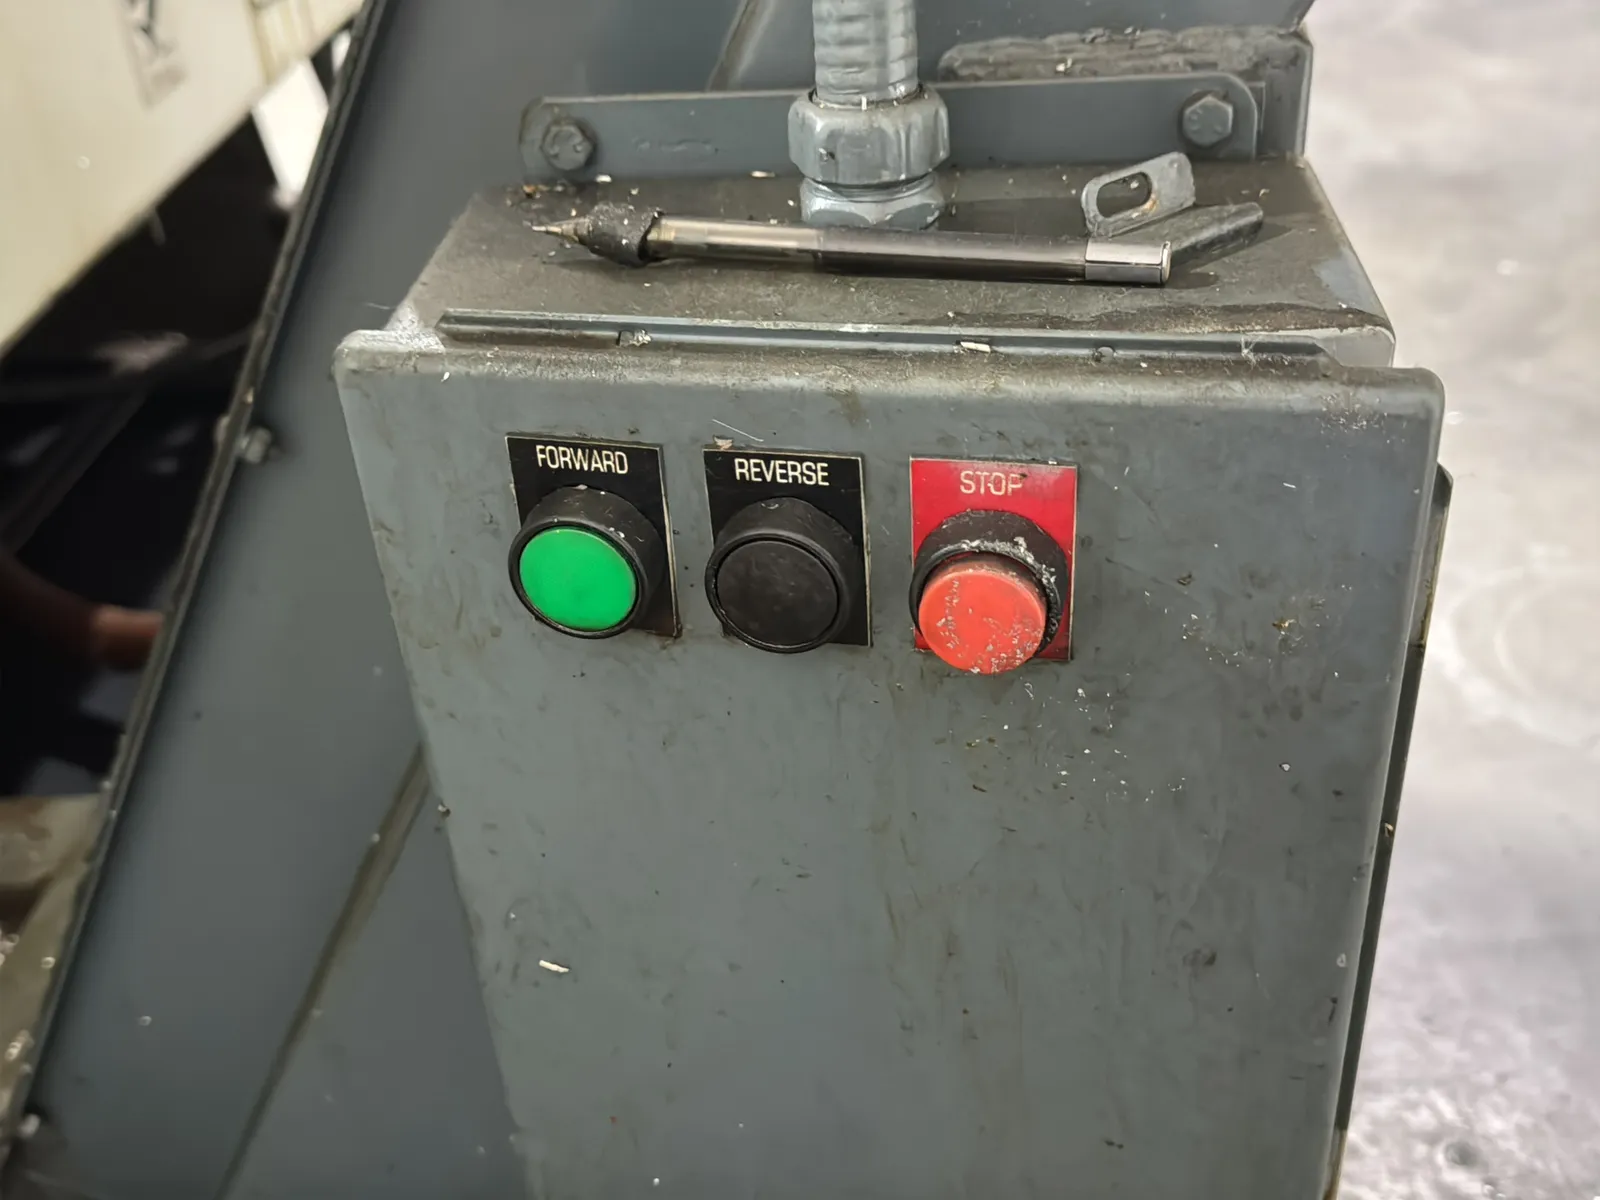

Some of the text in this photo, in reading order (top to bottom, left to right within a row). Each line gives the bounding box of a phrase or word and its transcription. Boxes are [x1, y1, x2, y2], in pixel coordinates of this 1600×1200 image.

[535, 444, 629, 475] FORWARD
[733, 457, 830, 487] REVERSE
[959, 469, 1024, 497] STOP
